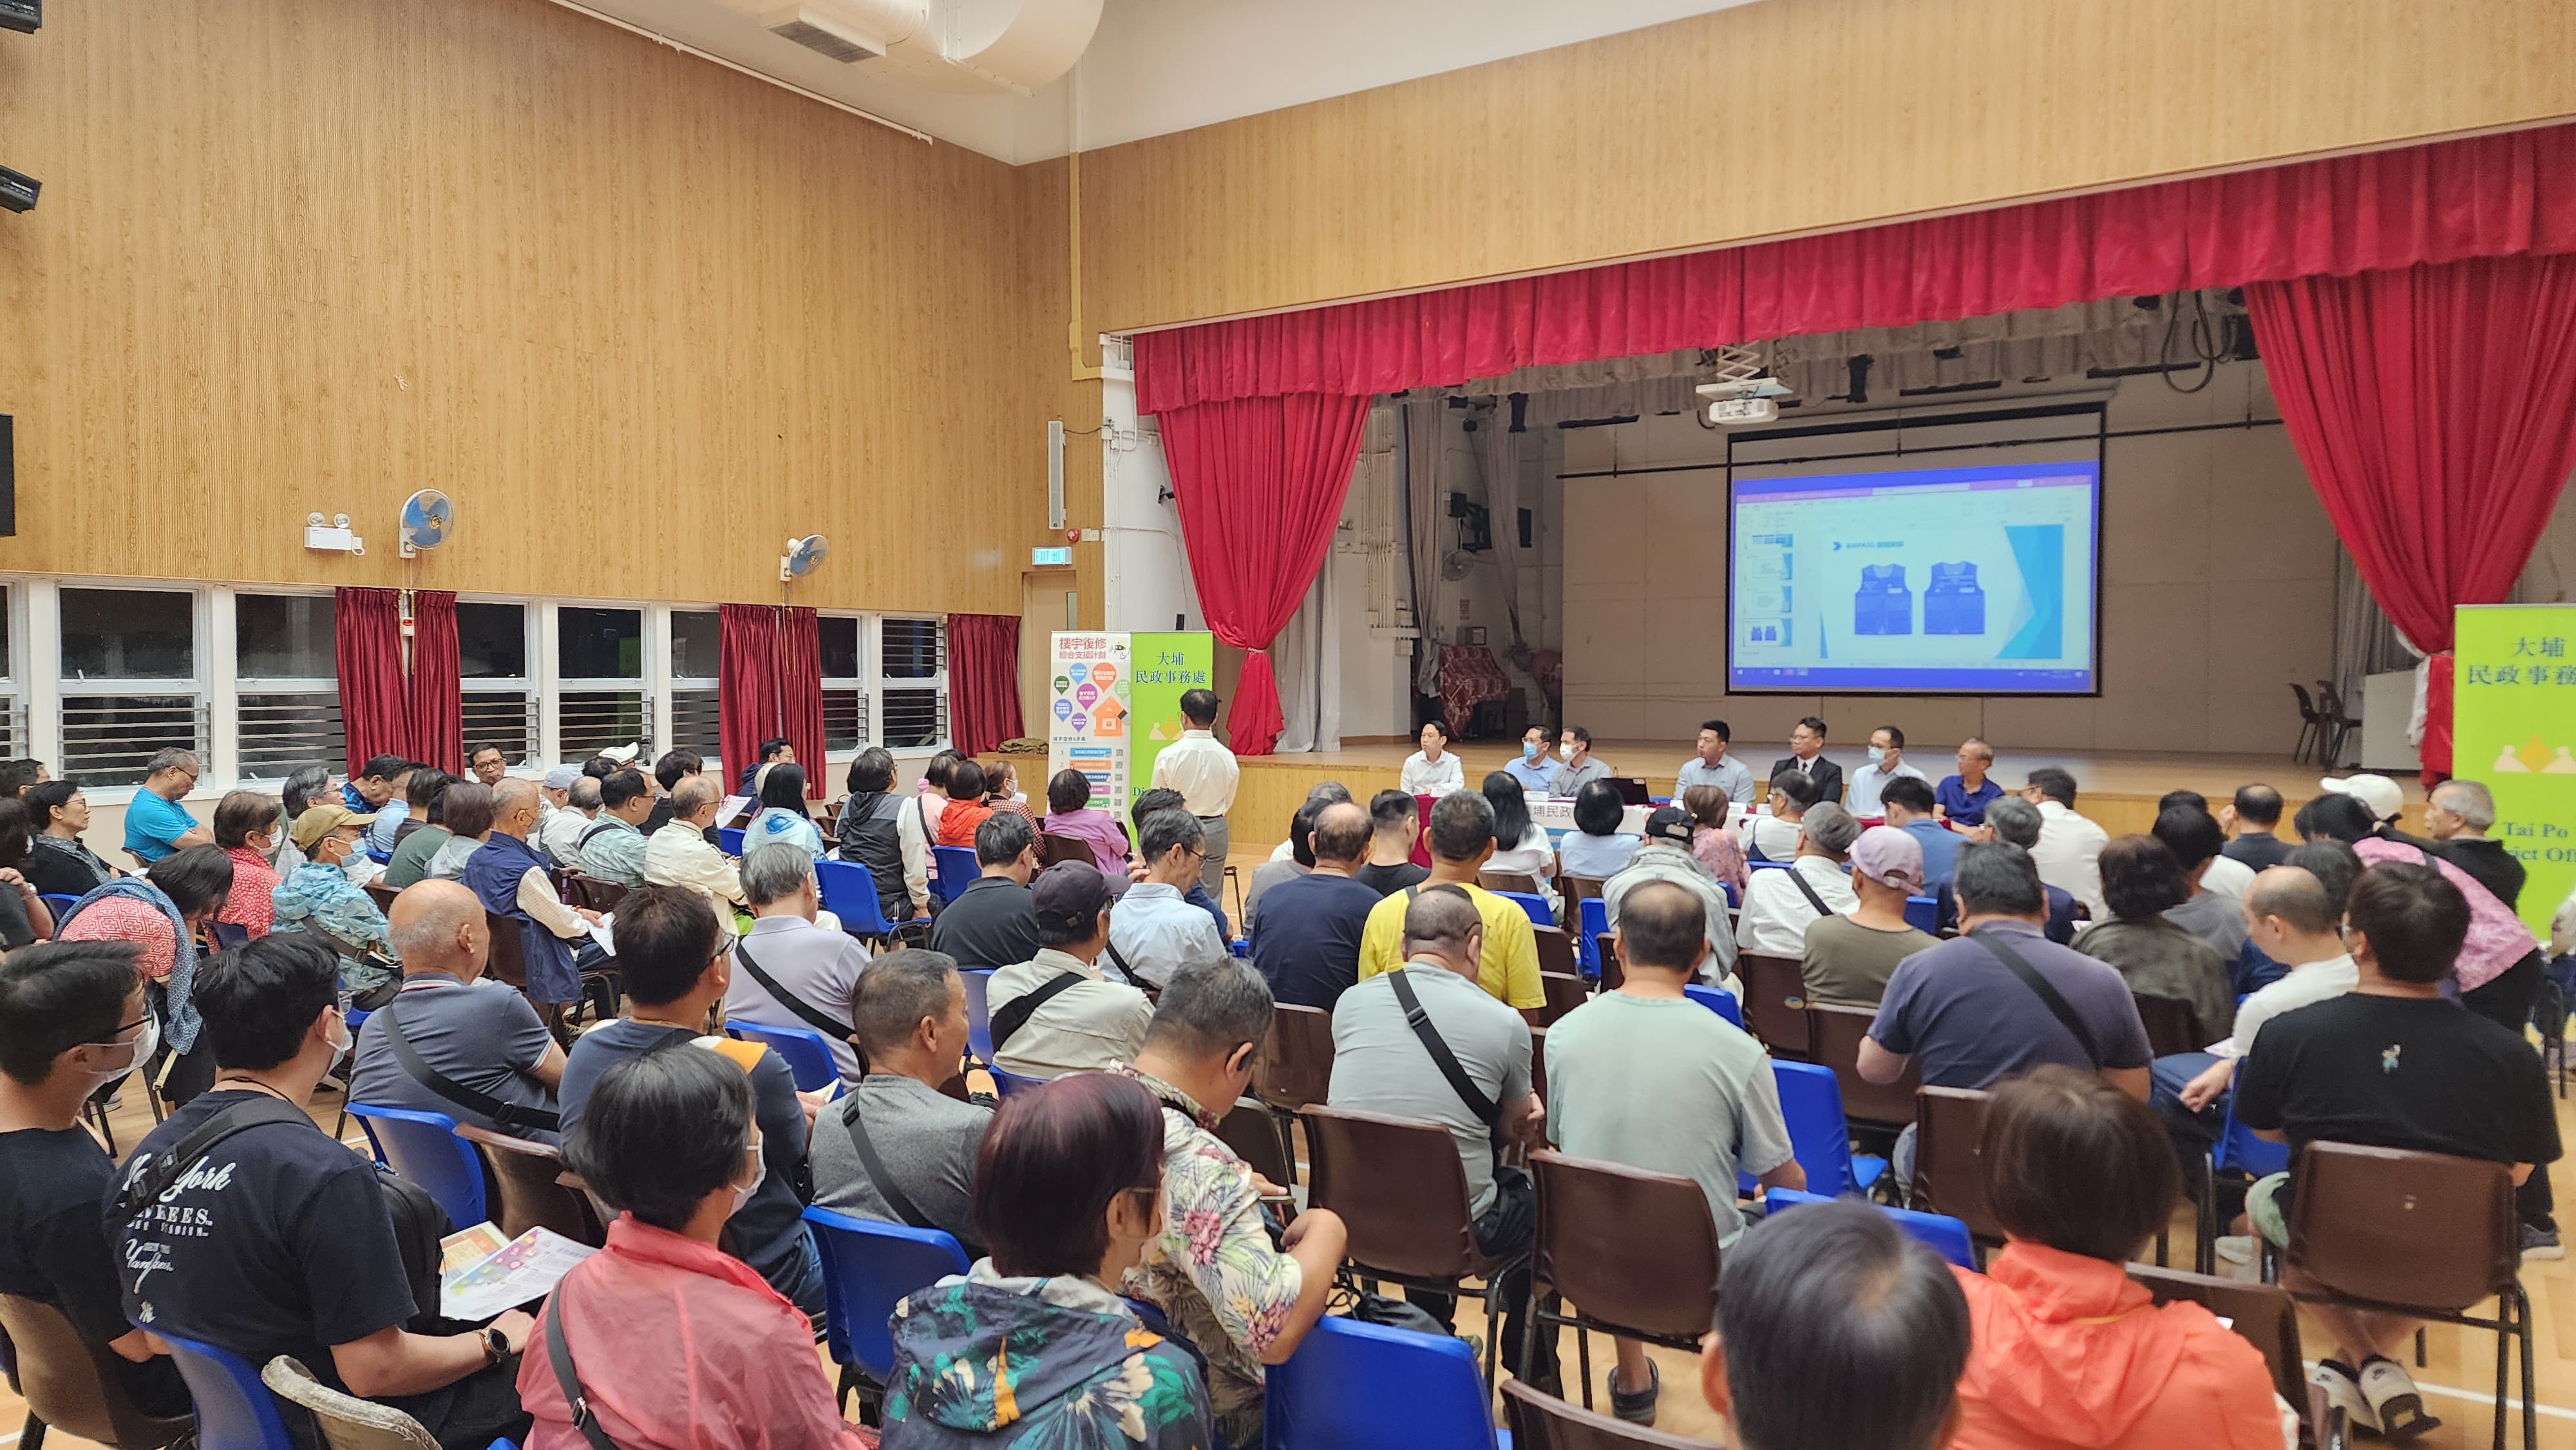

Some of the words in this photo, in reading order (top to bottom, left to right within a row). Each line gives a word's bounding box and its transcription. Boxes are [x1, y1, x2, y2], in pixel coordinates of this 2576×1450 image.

[1036, 551, 1050, 562] EXIT
[1052, 550, 1066, 562] 出口
[2510, 636, 2566, 657] 大埔
[1157, 652, 1184, 666] 大埔
[1135, 670, 1206, 684] 民政事務處
[1533, 804, 1572, 818] 埔民政
[2503, 822, 2535, 836] Tai
[2543, 824, 2568, 838] Po
